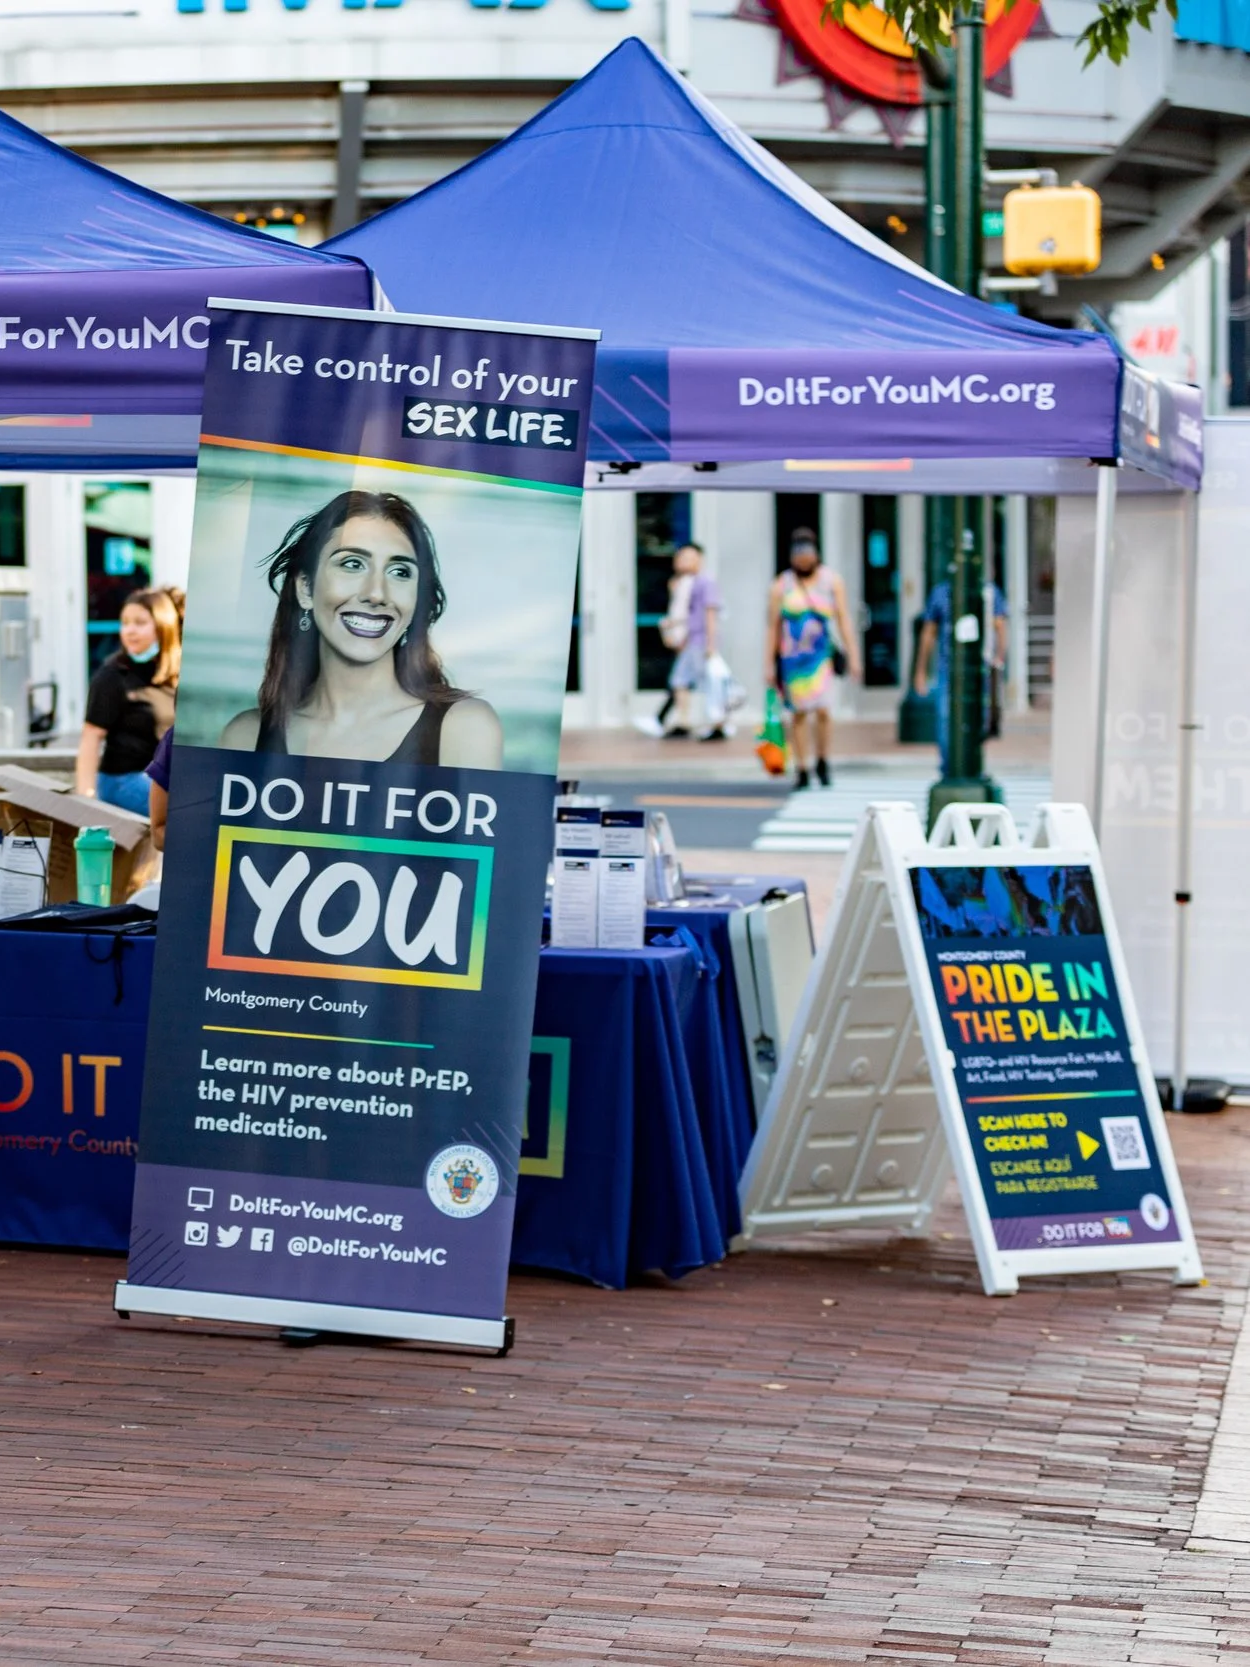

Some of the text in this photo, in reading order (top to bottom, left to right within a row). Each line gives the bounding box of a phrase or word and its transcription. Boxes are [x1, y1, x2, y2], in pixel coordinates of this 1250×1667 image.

[225, 339, 579, 401] Take control of your
[738, 374, 1057, 410] DoItForYouMC.org
[406, 402, 573, 447] SEX LIFE.
[220, 773, 498, 837] DO IT FOR
[239, 851, 463, 966] YOU
[940, 961, 1109, 1005] PRIDE IN
[205, 987, 368, 1018] Montgomery County
[951, 1007, 1117, 1044] THE PLAZA
[62, 1053, 122, 1117] IT
[199, 1049, 474, 1095] Learn more about PrEP,
[197, 1080, 414, 1118] the HIV prevention
[194, 1113, 328, 1141] medication.
[978, 1112, 1068, 1131] SCAN HERE TO
[229, 1194, 404, 1231] DoItForYouMC.org
[1042, 1221, 1105, 1241] DO IT FOR
[287, 1236, 448, 1266] @DoItForYouMC
